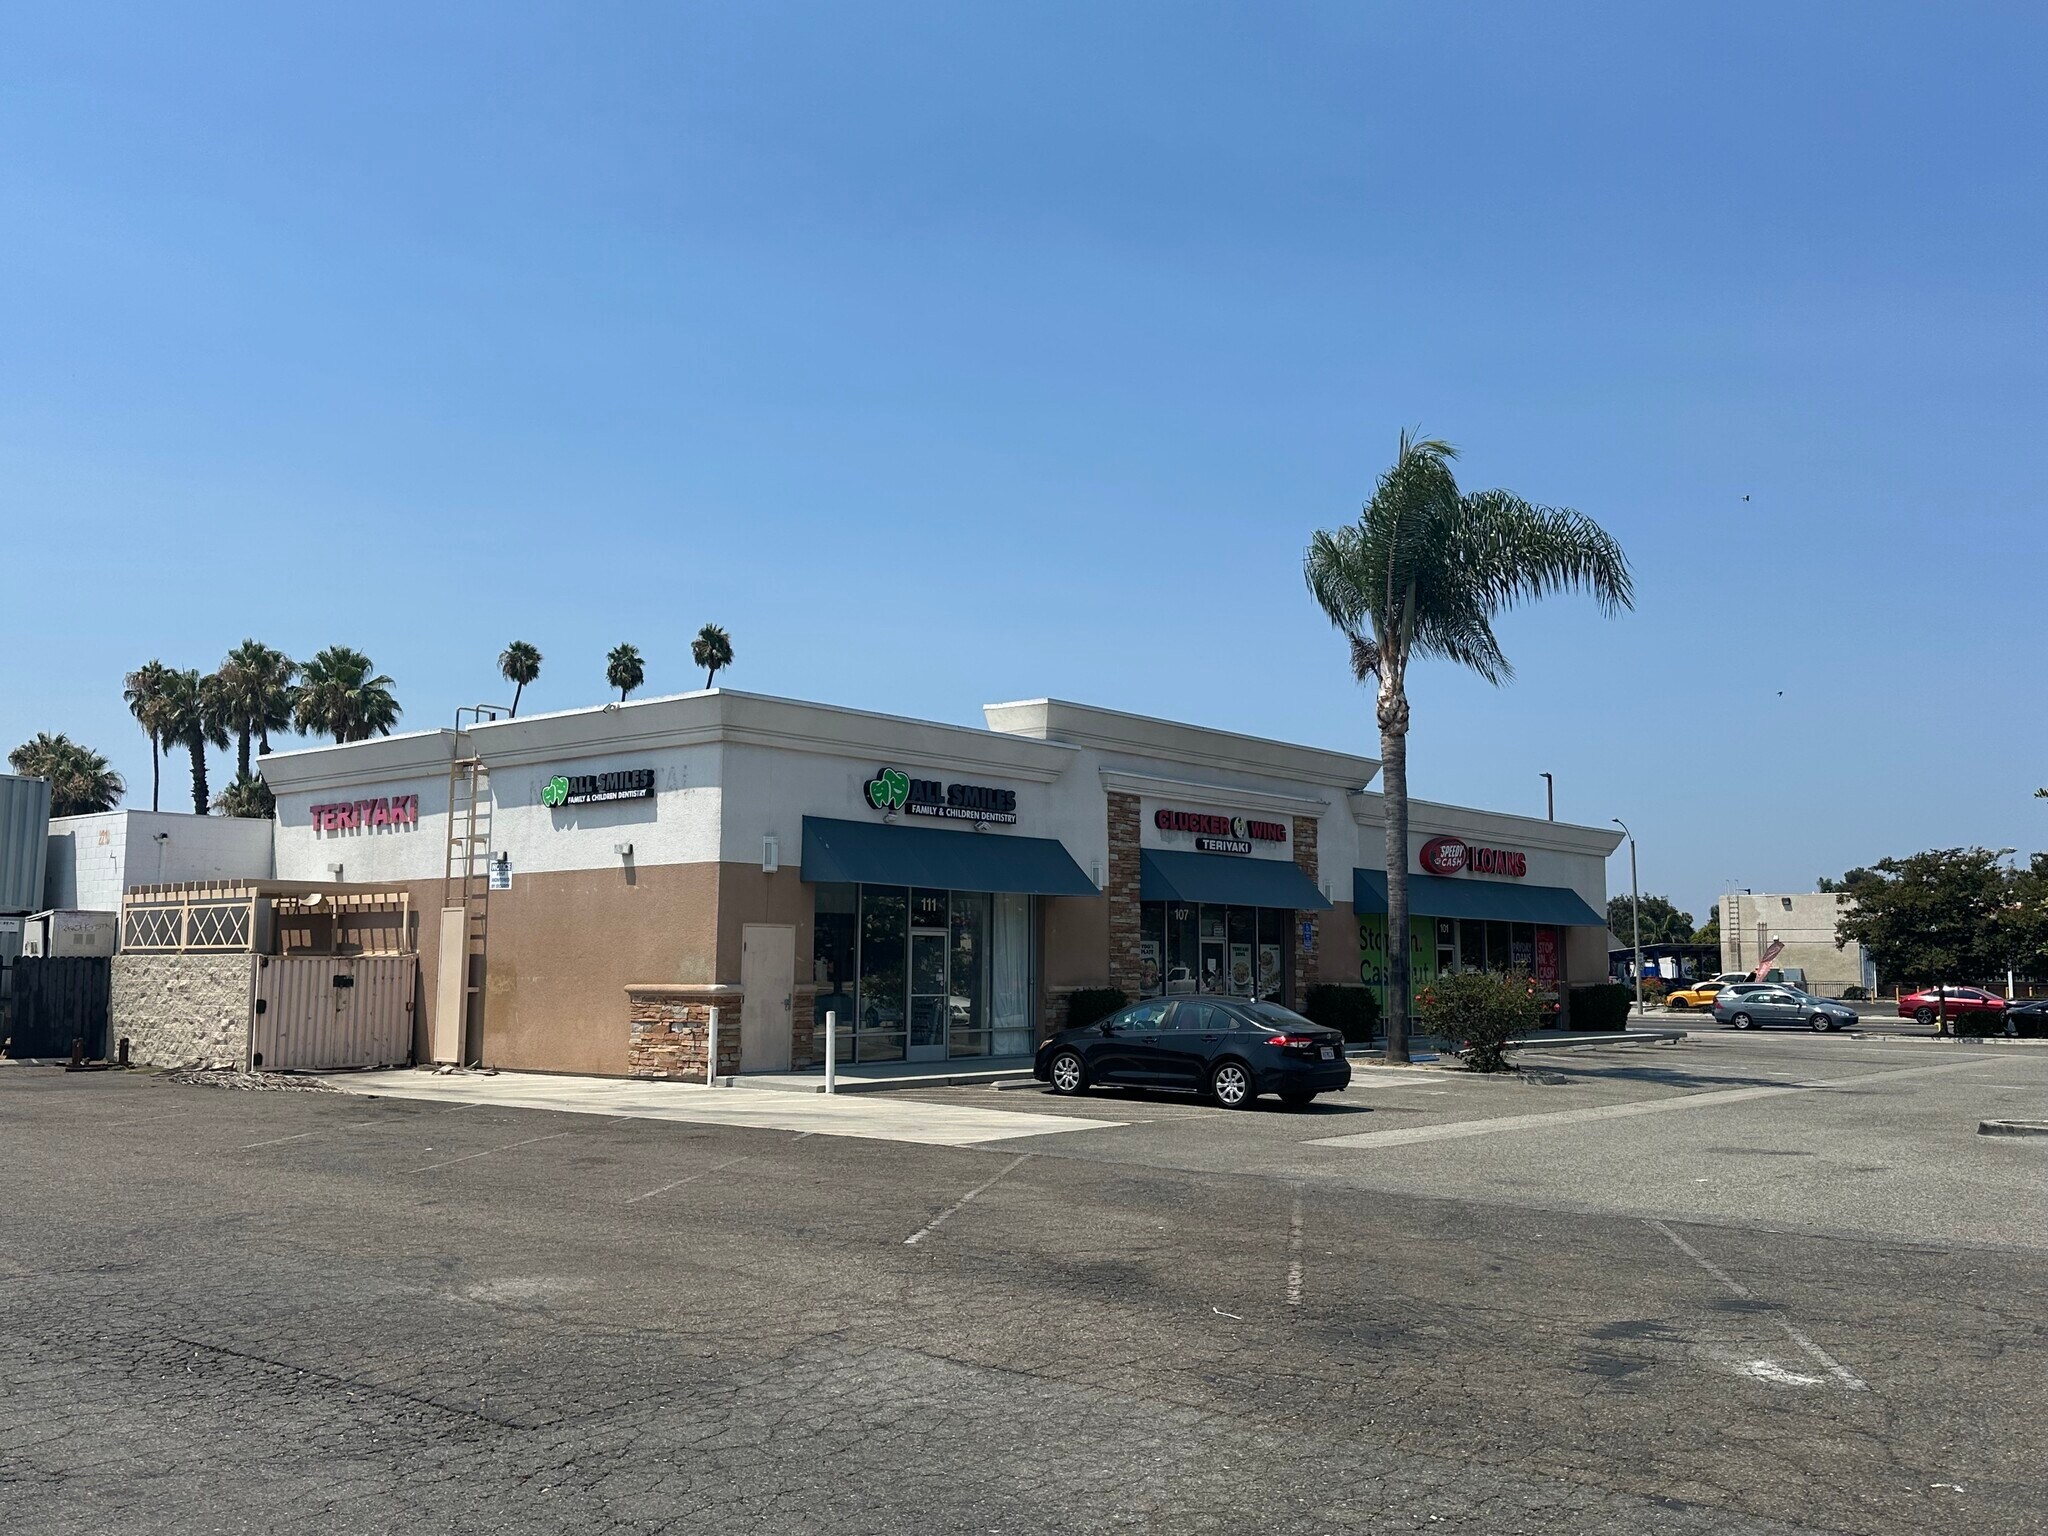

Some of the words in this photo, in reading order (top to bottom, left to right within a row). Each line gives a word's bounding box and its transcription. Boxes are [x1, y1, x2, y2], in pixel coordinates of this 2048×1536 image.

[569, 774, 594, 794] ALL
[597, 768, 652, 792] SMILES
[567, 793, 586, 804] FAMILY
[586, 794, 591, 802] &
[591, 791, 617, 801] CHILDREN
[617, 788, 647, 799] DENTISTRY
[910, 778, 945, 803] ALL
[949, 783, 1017, 812] SMILES
[309, 793, 419, 832] TERIYAKI
[911, 804, 937, 816] FAMILY
[938, 808, 944, 816] &
[945, 807, 980, 820] CHILDREN
[981, 811, 1016, 823] DENTISTRY
[1156, 809, 1230, 836] CLUCKER
[1248, 820, 1287, 842] WING
[1202, 839, 1249, 853] TERIYAKI
[1440, 844, 1465, 858] SPEEDY
[1472, 846, 1527, 878] LOANS
[921, 897, 937, 912] 111
[1174, 908, 1189, 921] 107
[1439, 923, 1449, 933] 101
[1538, 941, 1553, 953] STOP
[1360, 959, 1390, 986] Cas
[1539, 967, 1555, 979] CASH
